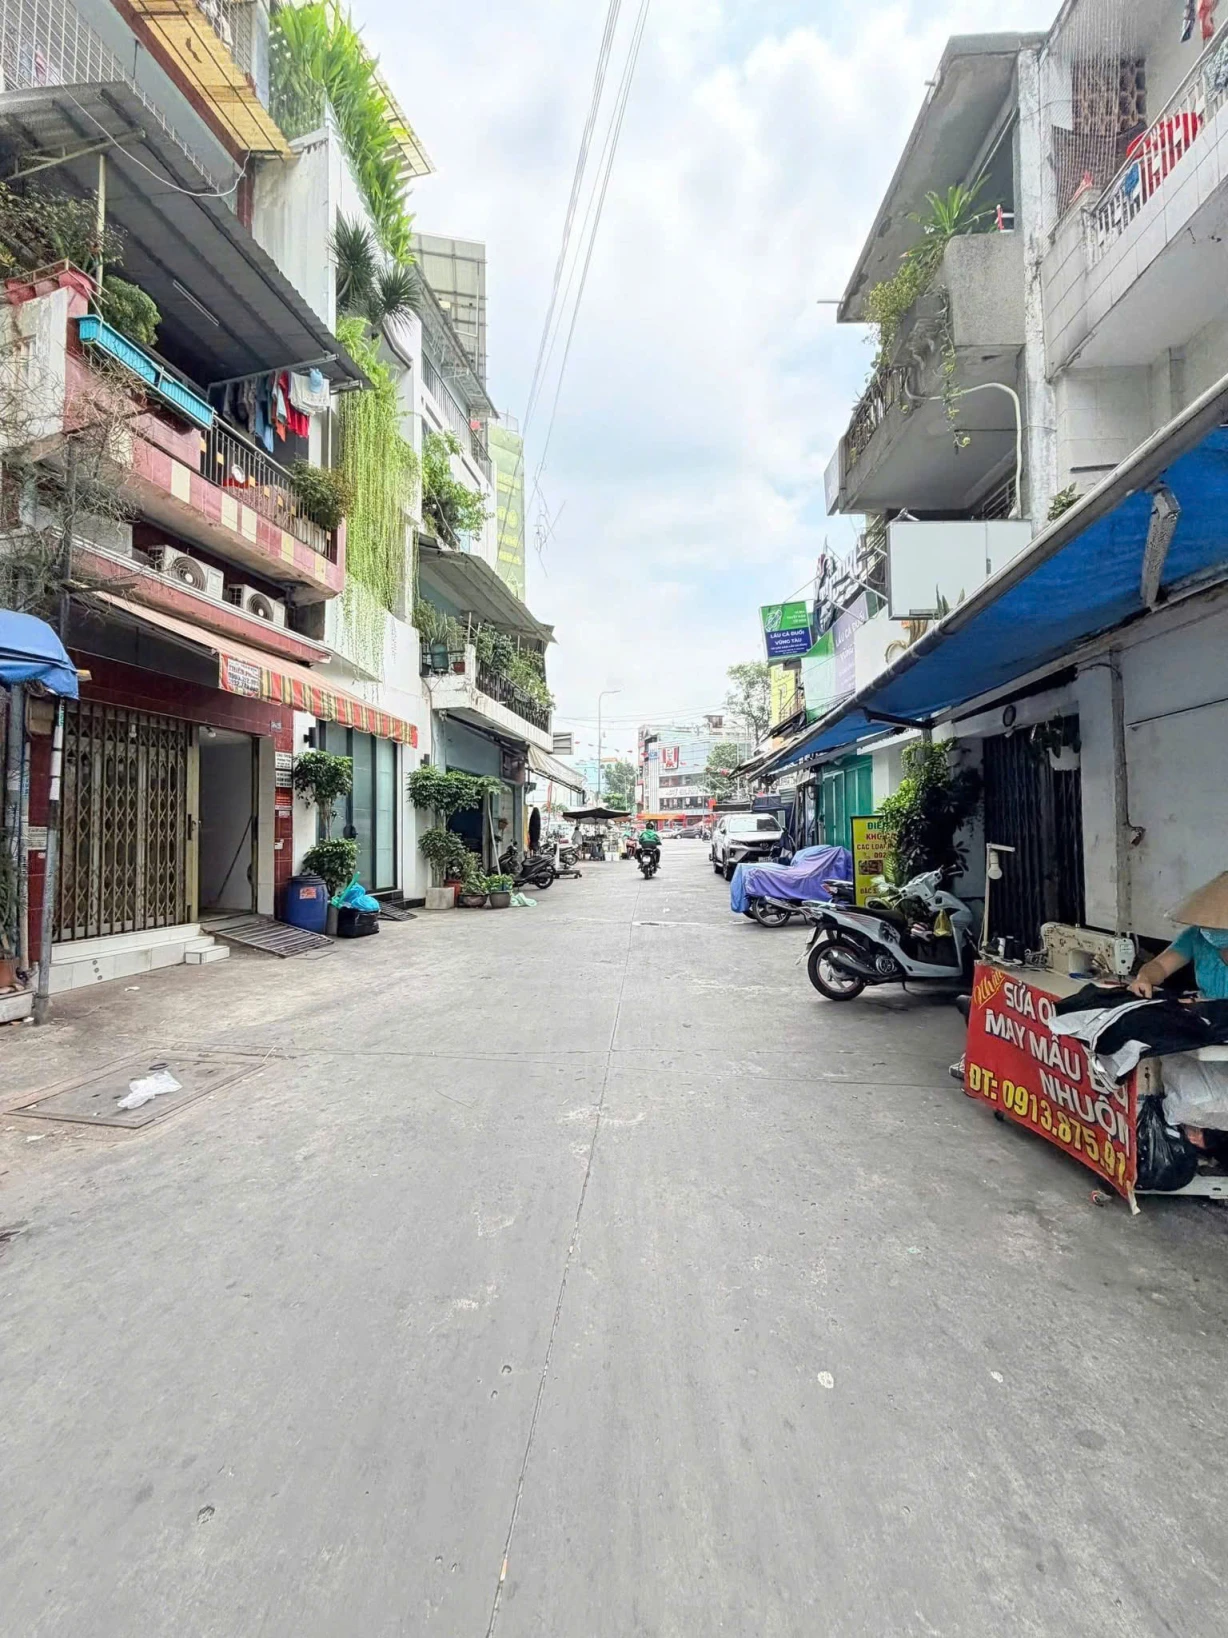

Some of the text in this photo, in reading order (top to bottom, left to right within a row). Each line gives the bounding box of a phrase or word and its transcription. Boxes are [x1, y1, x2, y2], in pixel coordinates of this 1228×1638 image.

[1004, 980, 1036, 1020] SỬA
[985, 1008, 1026, 1049] MAY
[969, 1062, 998, 1100] ĐT:
